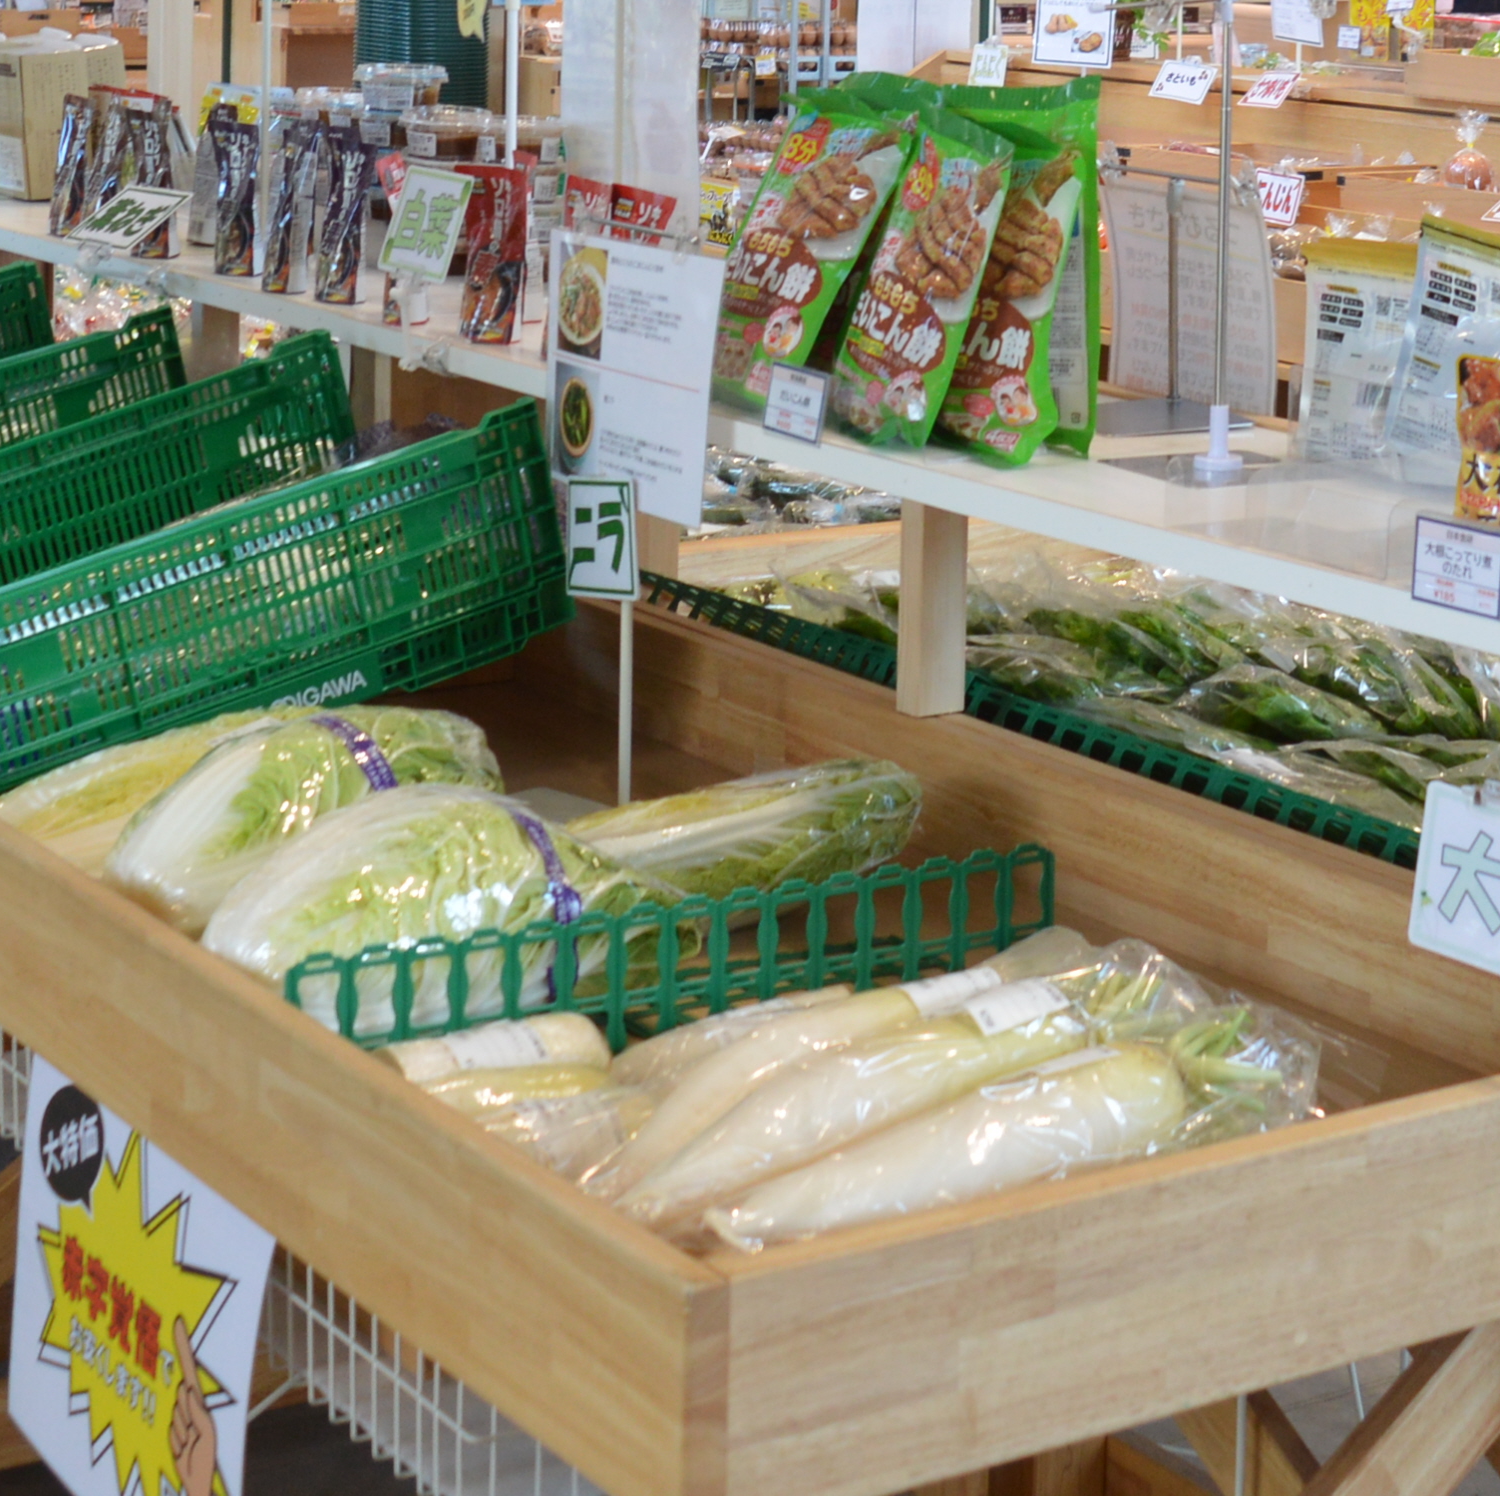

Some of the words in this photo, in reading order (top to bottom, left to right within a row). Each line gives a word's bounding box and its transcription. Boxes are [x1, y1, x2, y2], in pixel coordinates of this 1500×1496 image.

[1165, 71, 1198, 87] さといも
[398, 188, 465, 258] 白菜
[748, 232, 795, 257] もちもち
[873, 273, 920, 314] もちもち
[1424, 542, 1493, 570] 大根こってり煮
[1442, 561, 1473, 580] のたれ
[41, 1112, 100, 1178] 大特価
